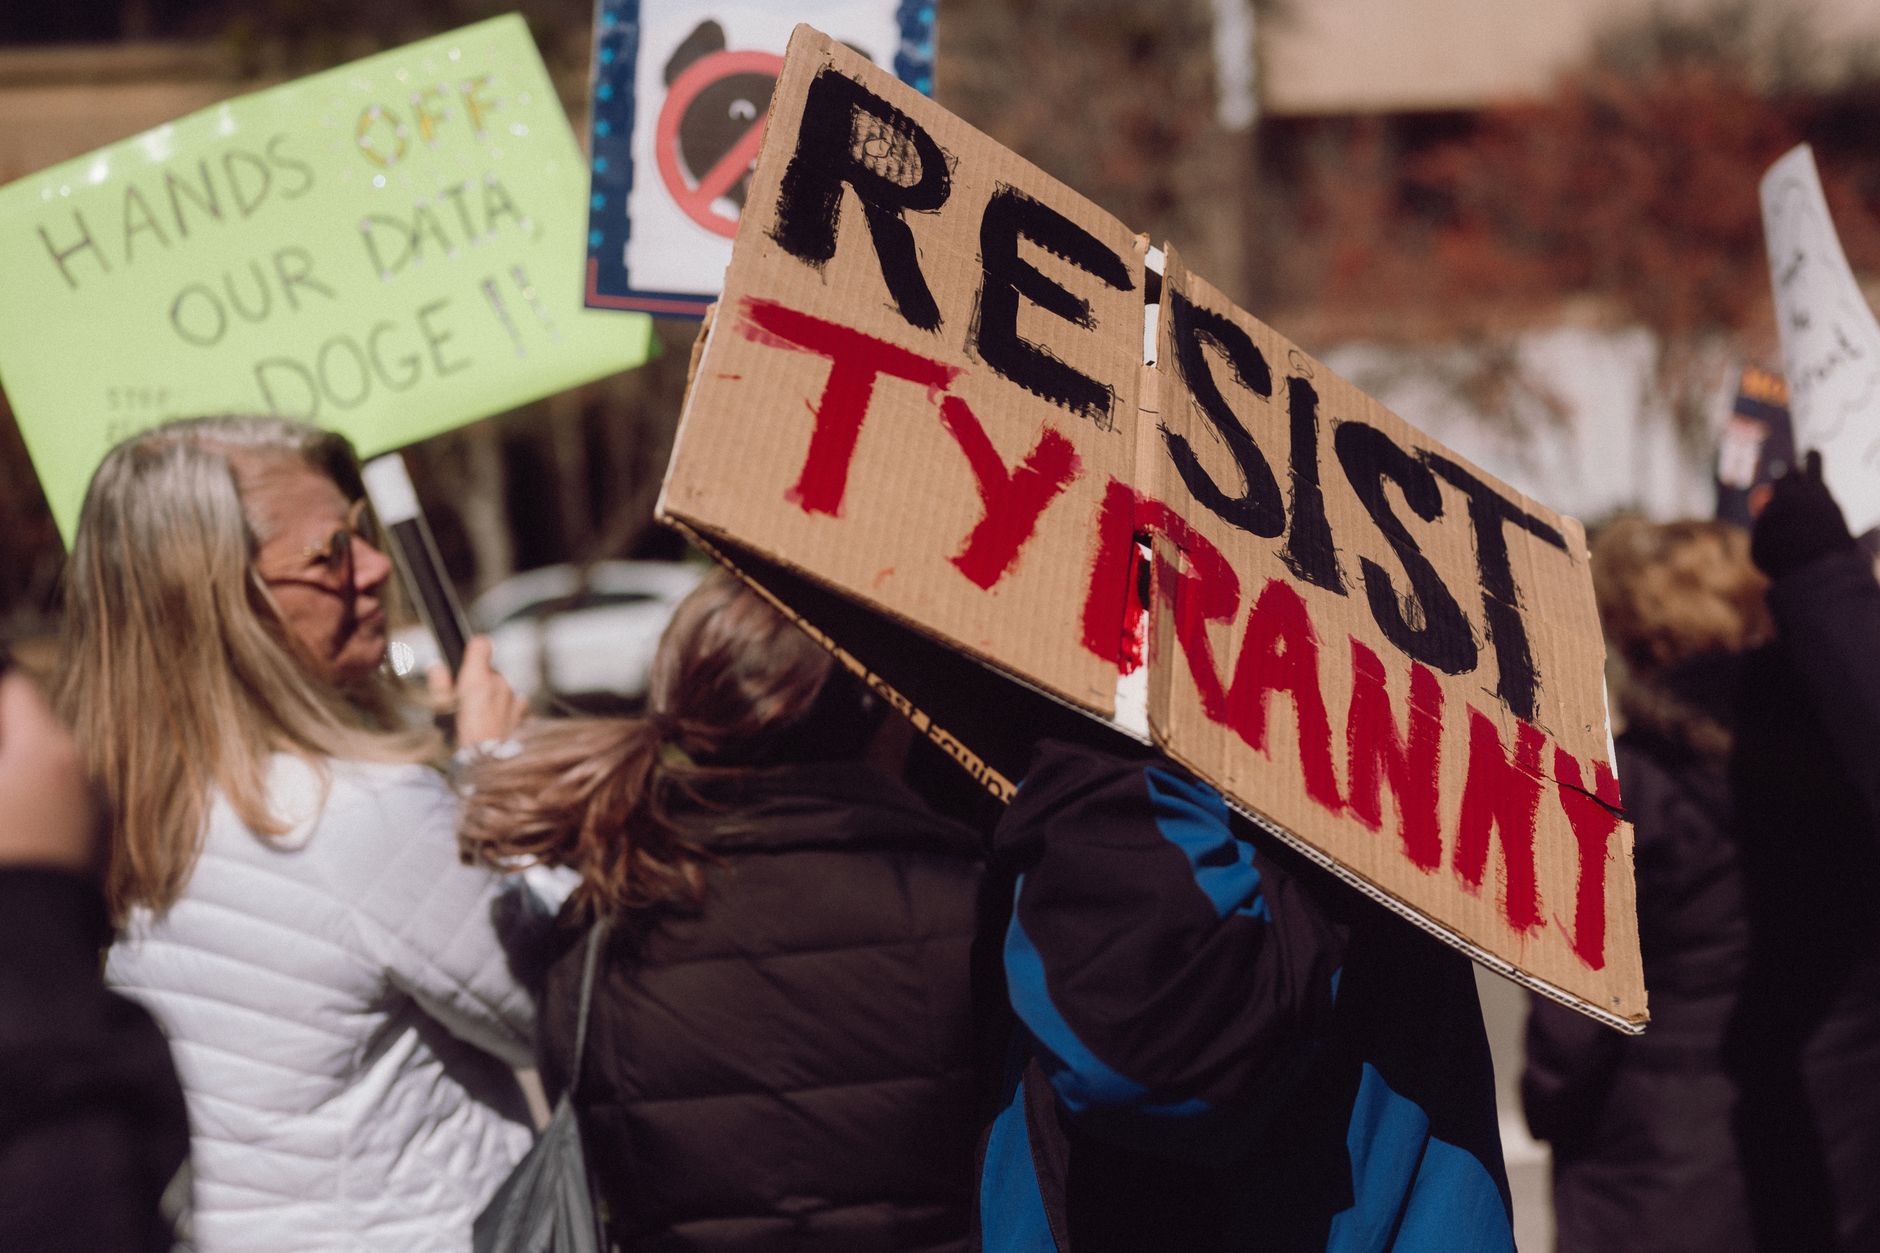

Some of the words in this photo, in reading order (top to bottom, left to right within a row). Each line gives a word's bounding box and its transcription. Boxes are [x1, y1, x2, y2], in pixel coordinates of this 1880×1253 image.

[36, 133, 316, 290] HANDS
[355, 72, 503, 169] OFF
[168, 245, 336, 347] OUR
[763, 62, 1575, 735] RESIST
[733, 293, 1626, 971] TYRANNY
